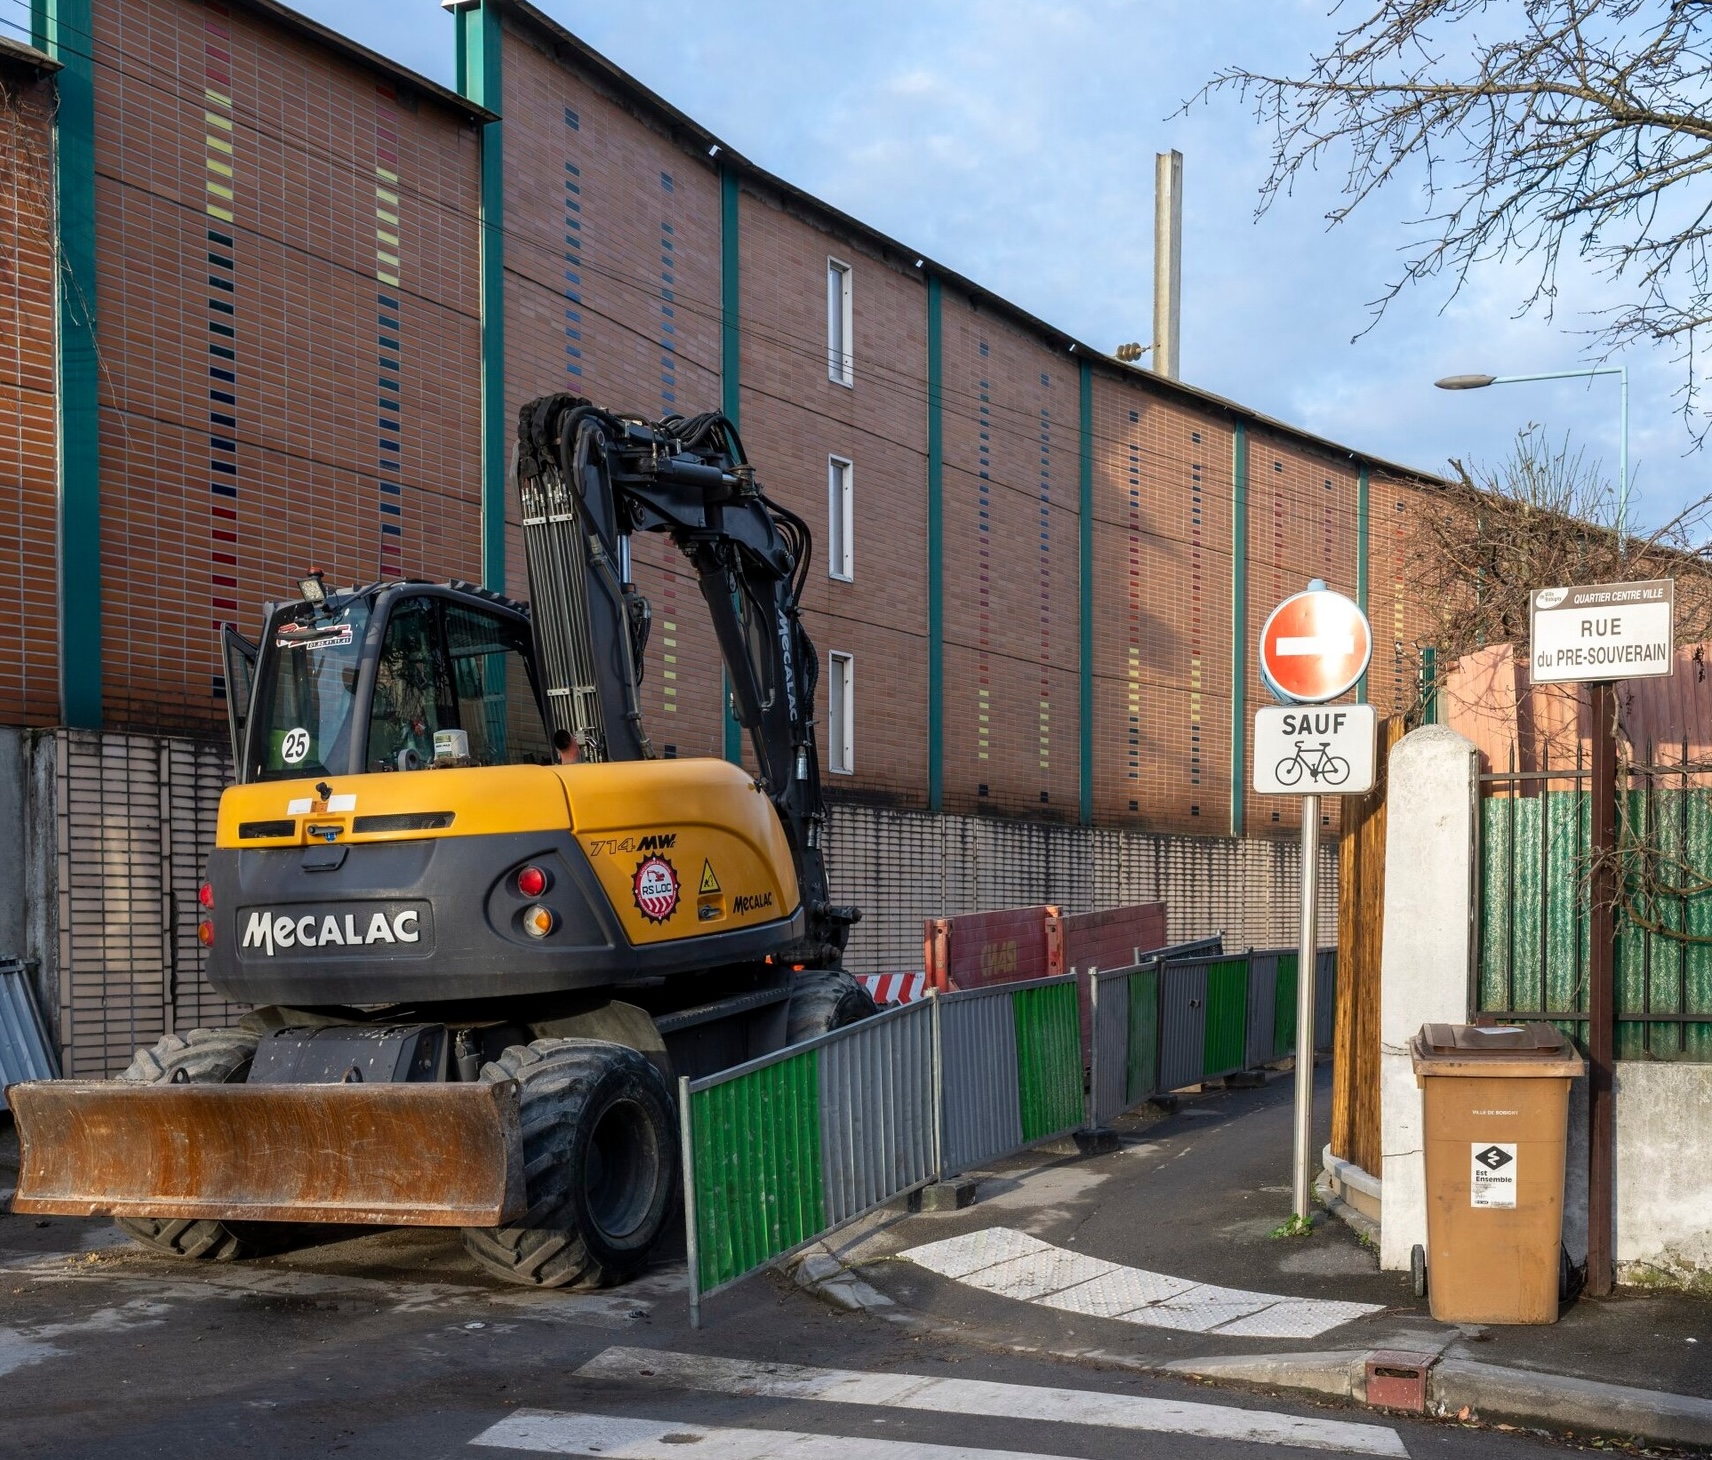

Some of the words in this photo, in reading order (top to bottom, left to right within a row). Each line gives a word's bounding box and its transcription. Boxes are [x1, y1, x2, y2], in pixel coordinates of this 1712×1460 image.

[1574, 592, 1611, 604] QUARTIER
[1612, 590, 1641, 602] CENTRE
[1642, 588, 1664, 599] VILLE
[1581, 618, 1622, 637] RUE
[1537, 651, 1552, 668] du
[1557, 643, 1666, 666] PRE-SOUVERAIN
[1281, 713, 1347, 736] SAUF
[284, 732, 307, 758] 25
[590, 837, 635, 857] 714
[642, 885, 655, 896] RS
[655, 882, 672, 894] LOC
